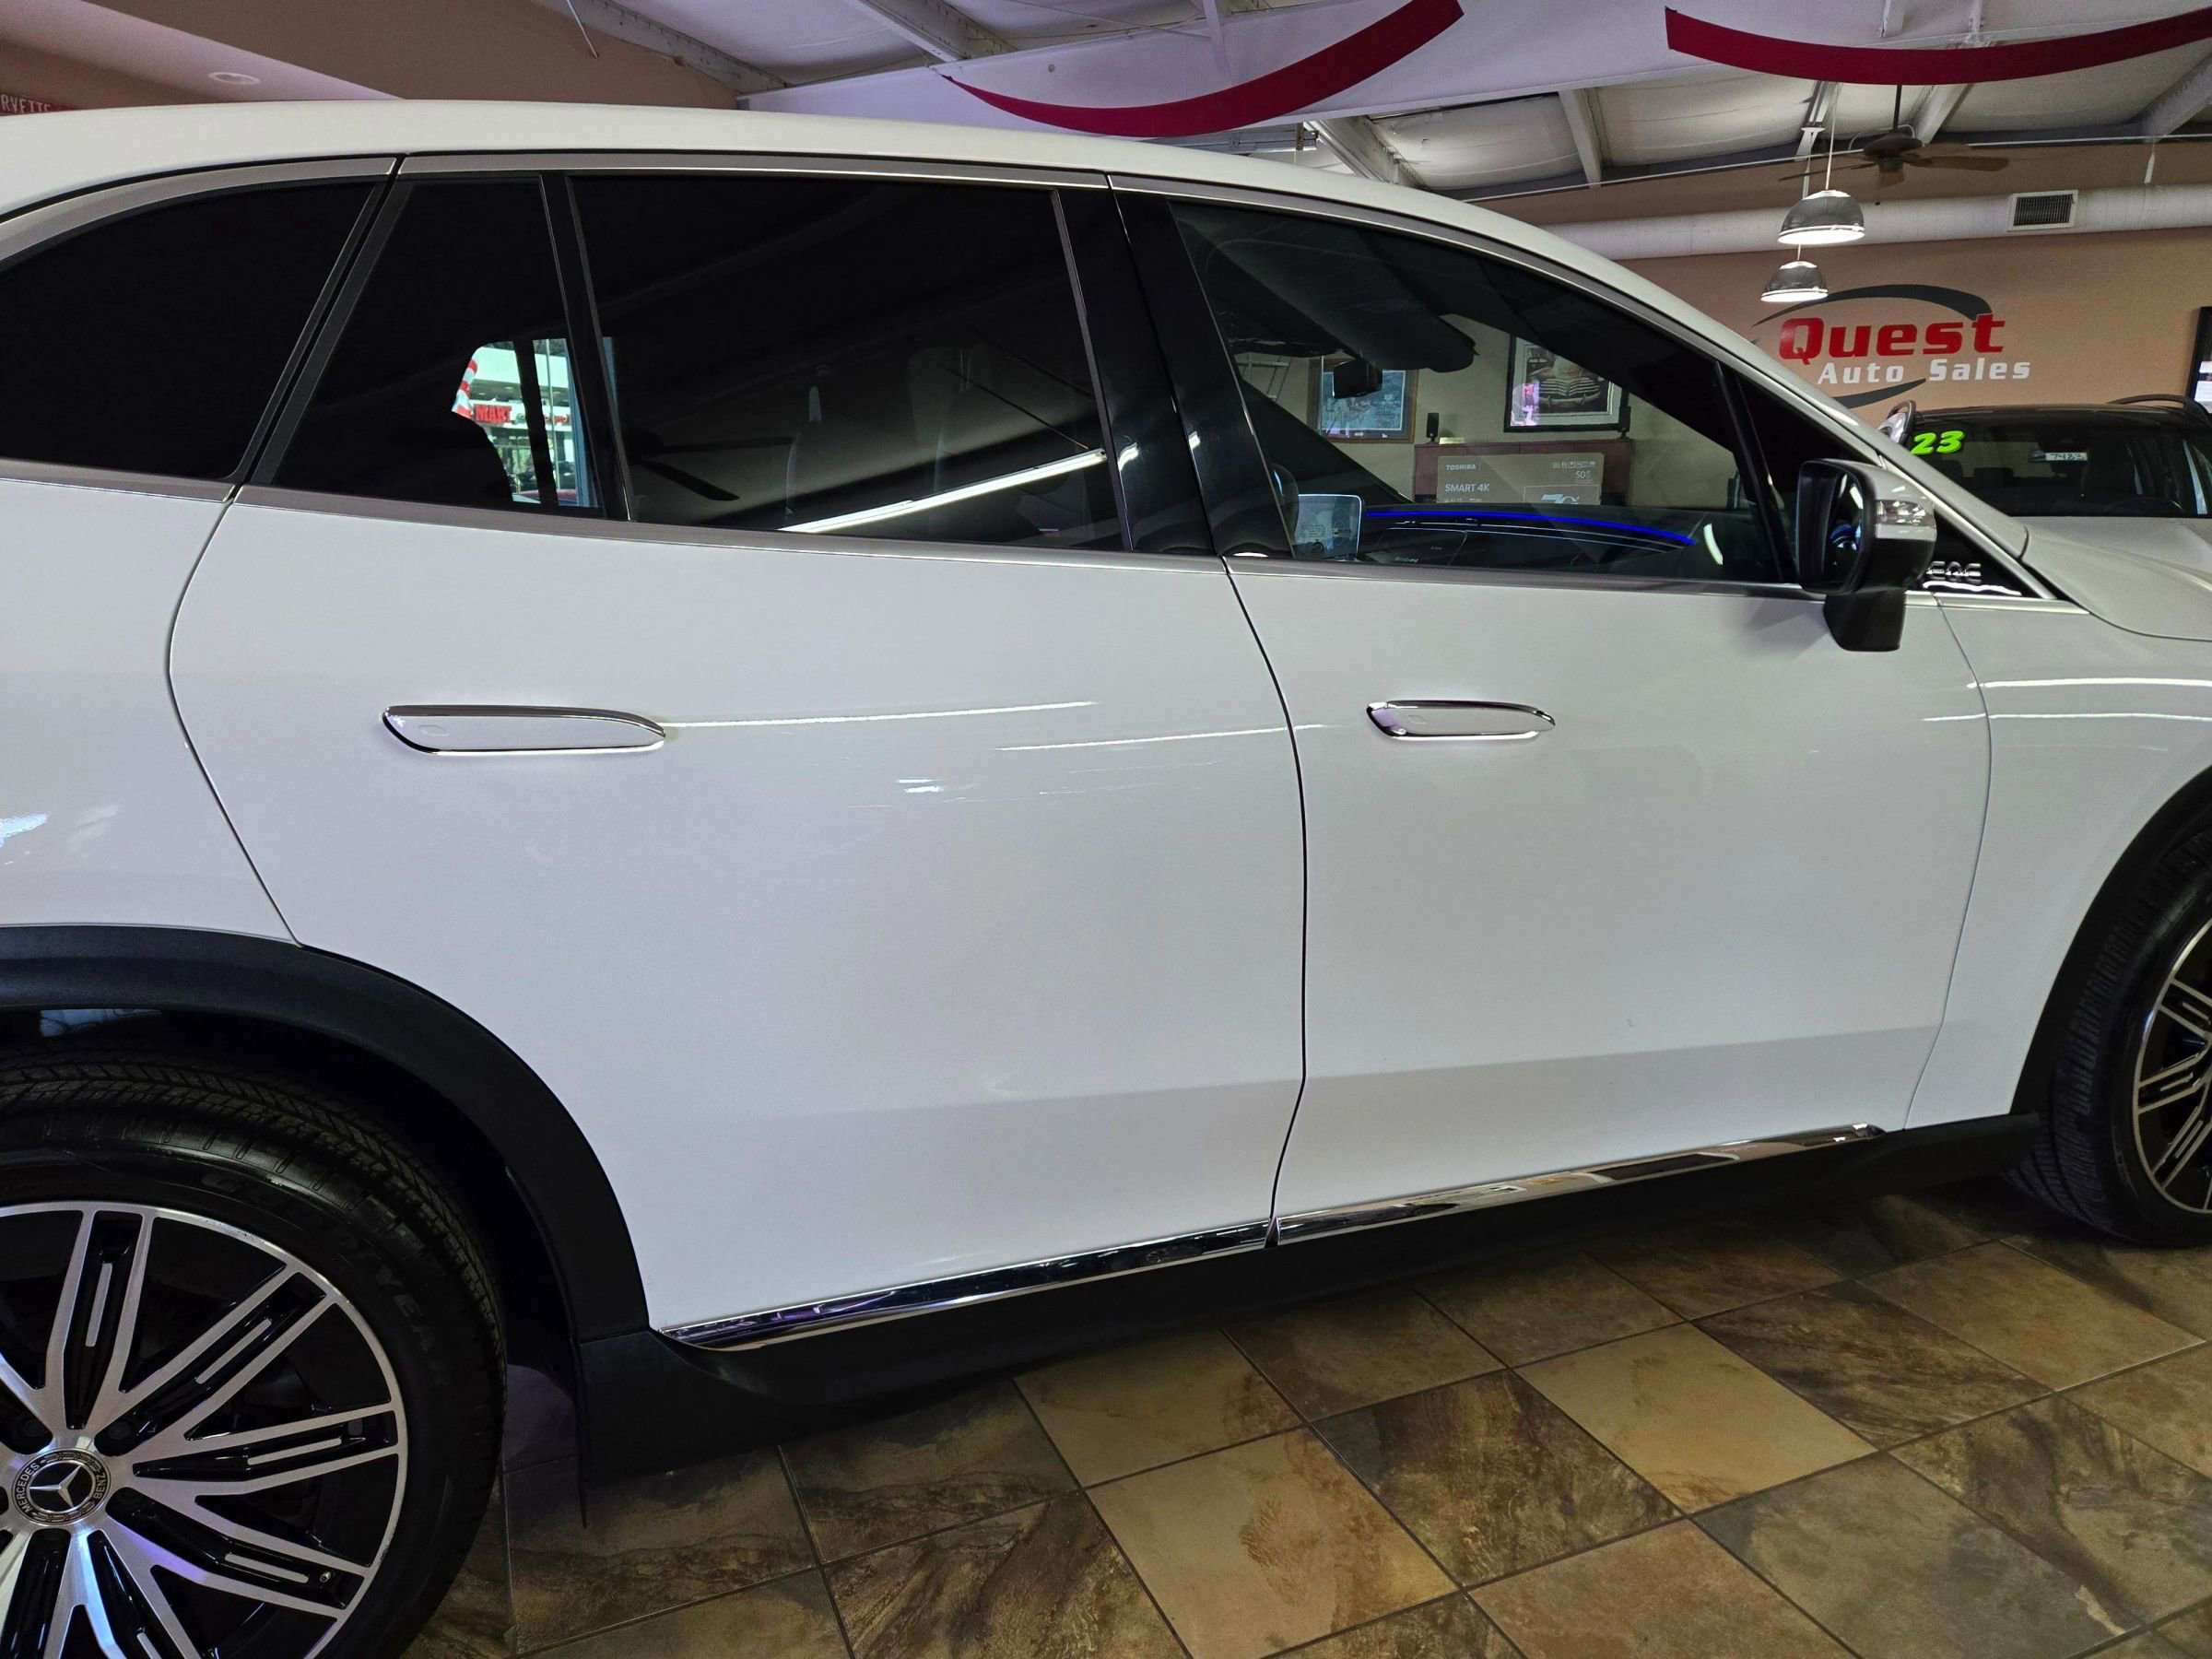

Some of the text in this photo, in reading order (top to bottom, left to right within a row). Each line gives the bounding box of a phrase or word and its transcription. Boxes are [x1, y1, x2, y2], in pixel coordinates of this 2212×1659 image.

[1779, 313, 2006, 366] Quest
[1817, 357, 2030, 385] Auto Sales
[1911, 429, 1965, 455] 23
[1444, 483, 1490, 492] SMART 4K
[16, 1462, 41, 1513] MERCEDES
[93, 1472, 108, 1500] BENZ
